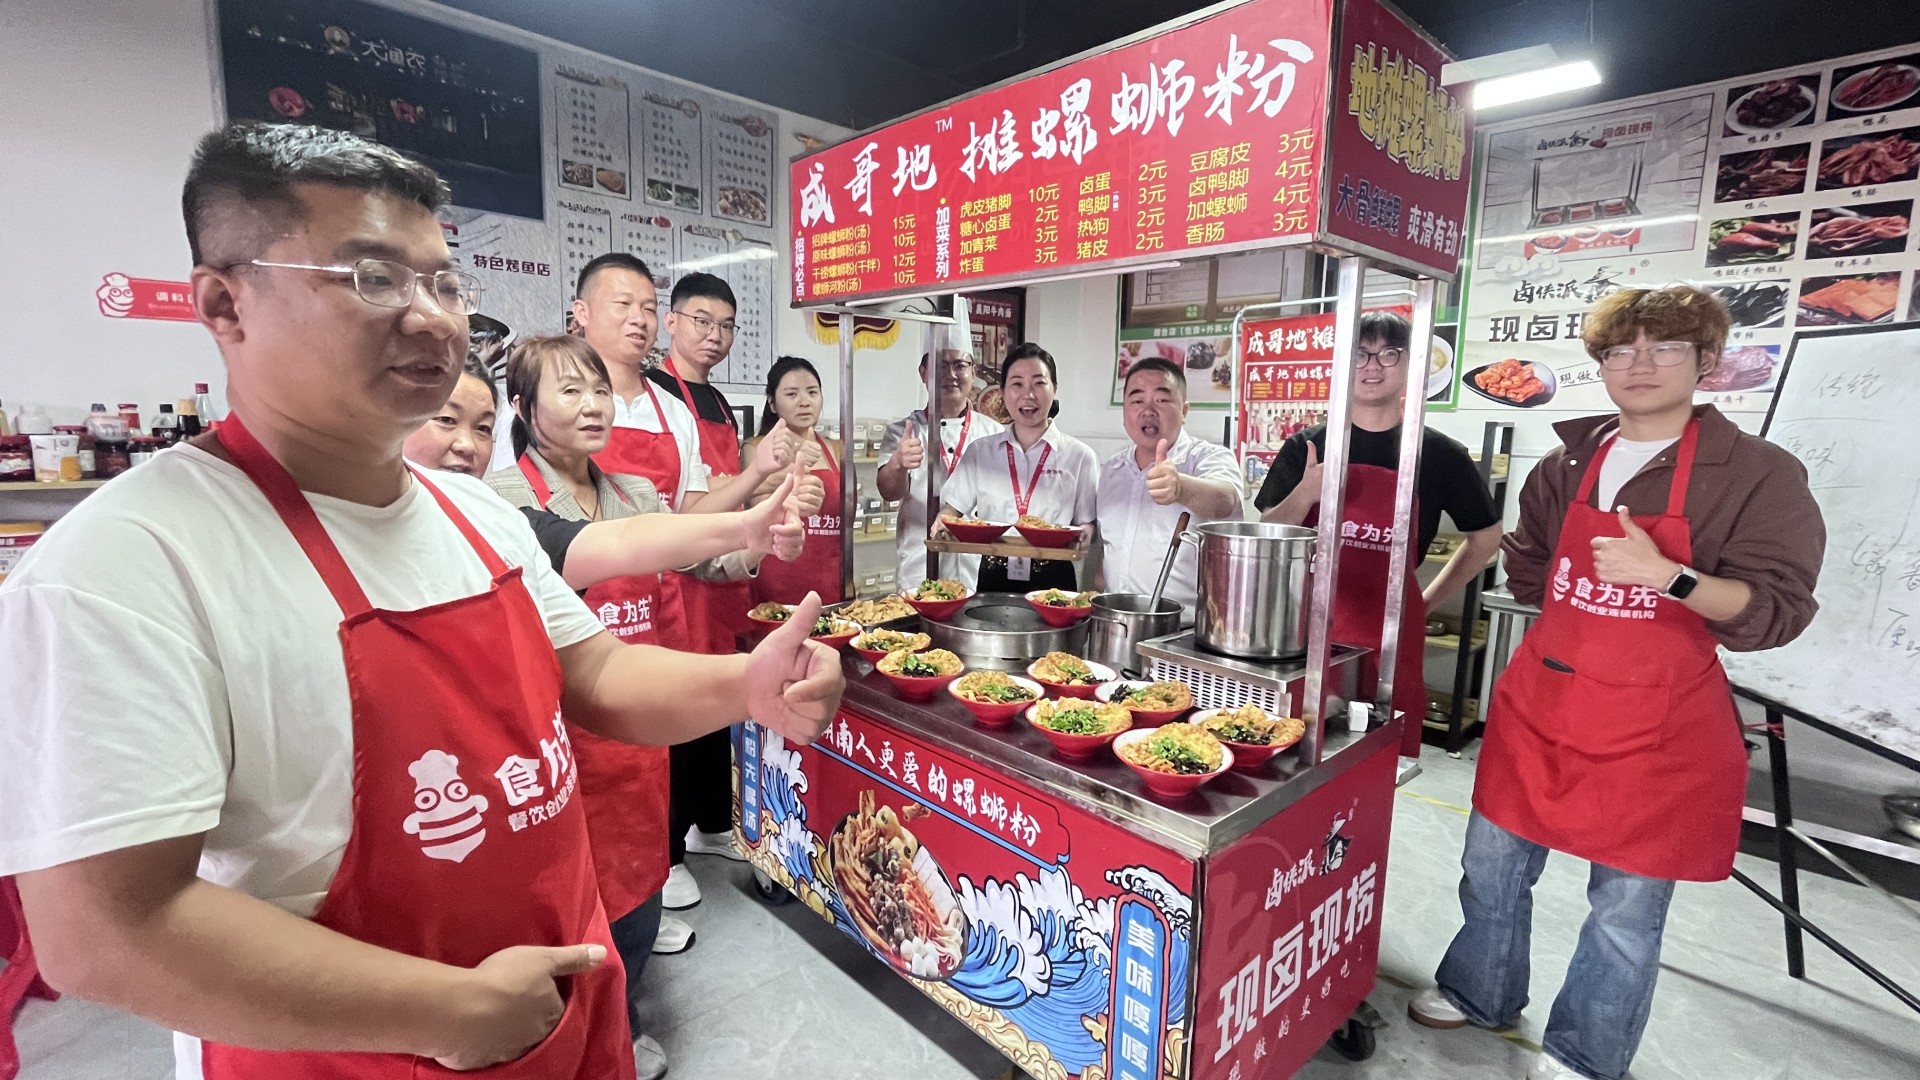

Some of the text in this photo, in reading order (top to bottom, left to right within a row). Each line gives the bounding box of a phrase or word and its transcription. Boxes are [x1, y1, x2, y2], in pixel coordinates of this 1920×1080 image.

[935, 118, 953, 133] TM
[1188, 128, 1315, 173] 豆腐皮 3元
[1079, 160, 1167, 195] 卤蛋 2元
[1188, 155, 1313, 198] 卤鸭脚 4元
[960, 183, 1060, 218] 虎皮猪脚 10元
[1078, 194, 1110, 217] 鸭脚
[1137, 183, 1166, 205] 3元
[1186, 182, 1311, 222] 加螺蛳 4元
[893, 213, 916, 230] 15元
[960, 204, 1059, 237] 糖心卤蛋 2元
[1077, 207, 1165, 238] 热狗 2元
[1185, 209, 1309, 245] 香肠 3元
[1406, 204, 1458, 257] 爽滑有劲
[893, 231, 916, 247] 10元
[936, 206, 950, 279] 加菜系列
[960, 225, 1058, 256] 加青菜 3元
[1076, 230, 1164, 260] 猪皮 2元
[473, 254, 550, 277] 特色烤鱼店
[795, 237, 805, 297] 招牌必点
[893, 252, 916, 267] 12元
[959, 246, 1058, 274] 炸蛋 3元
[893, 269, 916, 284] 10元
[156, 291, 193, 304] 调料
[1559, 368, 1602, 385] 现做
[1575, 577, 1657, 608] 食为先
[597, 597, 650, 626] 食为先
[1570, 597, 1655, 620] 餐饮创业连锁机构
[1214, 860, 1378, 1064] 现卤现捞
